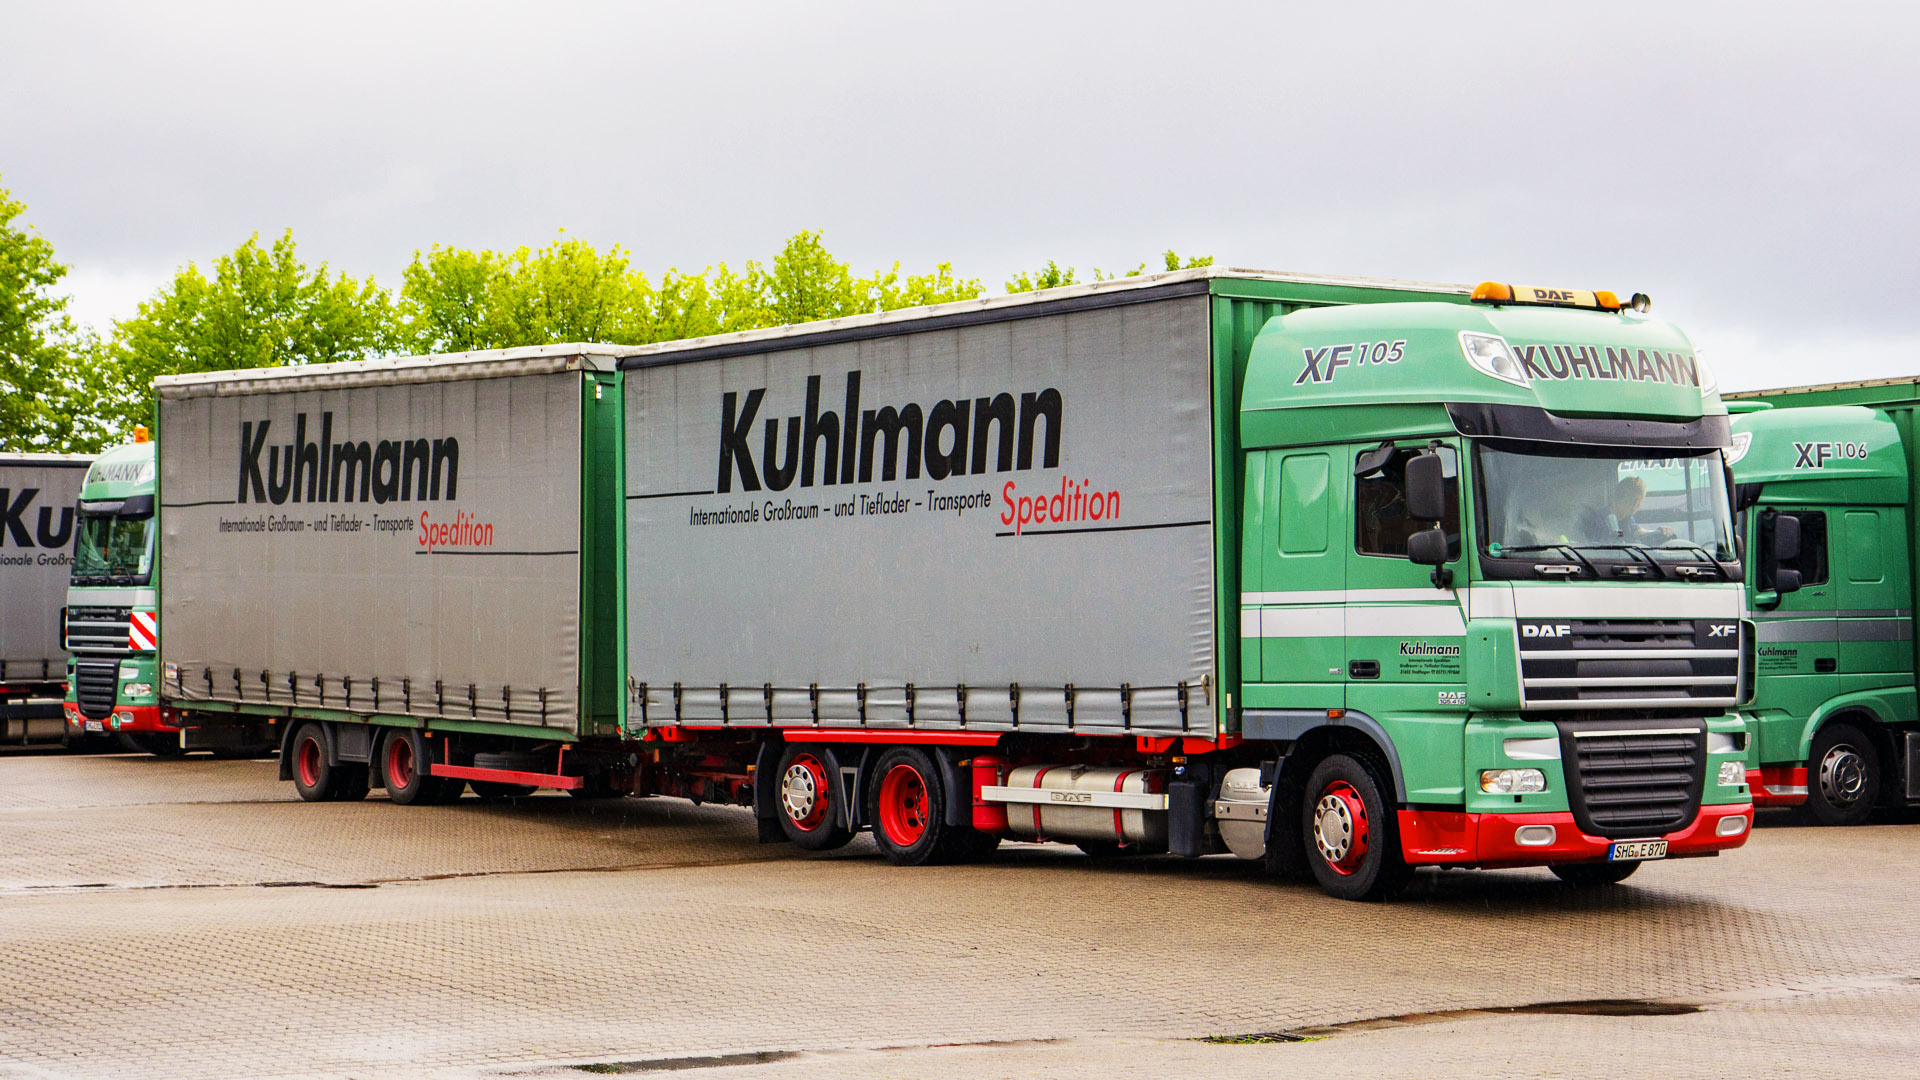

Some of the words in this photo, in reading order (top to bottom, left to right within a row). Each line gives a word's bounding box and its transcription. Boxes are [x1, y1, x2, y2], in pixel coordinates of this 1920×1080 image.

[1534, 289, 1575, 301] DAF
[1294, 345, 1354, 386] XF
[1358, 340, 1407, 366] 105
[1512, 345, 1701, 388] KUHLMANN
[717, 370, 1063, 494] Kuhlmann
[238, 411, 459, 505] Kuhlmann
[1792, 442, 1833, 469] XF
[1835, 441, 1868, 461] 106
[690, 501, 759, 526] Internationale
[763, 499, 819, 522] Großraum
[834, 494, 855, 518] und
[860, 492, 910, 516] Tieflader
[927, 490, 991, 516] Transporte
[1001, 476, 1120, 535] Spedition
[219, 515, 265, 533] Internationale
[268, 515, 304, 532] Großraum
[314, 514, 328, 532] und
[331, 514, 363, 532] Tieflader
[373, 514, 414, 536] Transporte
[418, 509, 493, 554] Spedition
[1522, 625, 1571, 637] DAF
[1708, 625, 1736, 637] XF
[1399, 641, 1460, 655] Kuhlmann
[1051, 792, 1091, 802] DAF
[1615, 845, 1634, 858] SHG
[1640, 844, 1647, 857] E
[1648, 843, 1666, 856] 870
